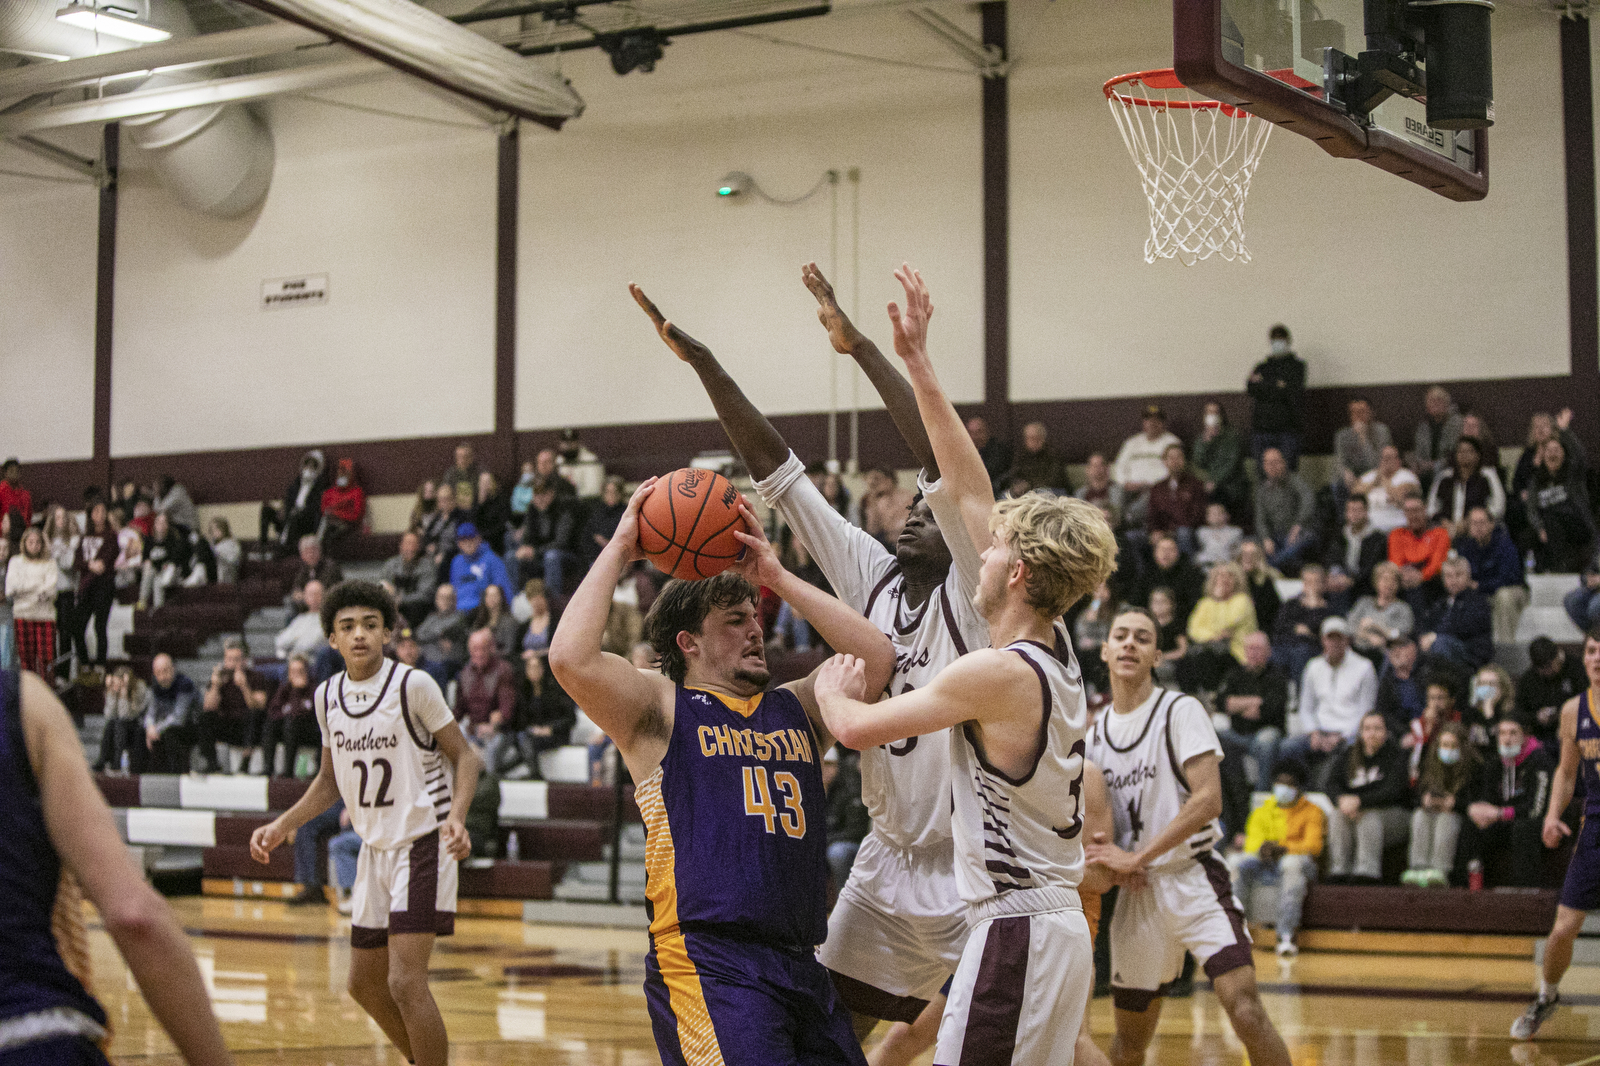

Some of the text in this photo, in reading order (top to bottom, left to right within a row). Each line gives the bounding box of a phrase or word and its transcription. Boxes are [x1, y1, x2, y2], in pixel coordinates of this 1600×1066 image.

[334, 727, 397, 754] Panthers
[697, 724, 814, 765] CHRISTIAN
[352, 758, 395, 808] 22
[1103, 758, 1158, 790] Panthrs
[742, 766, 807, 839] 43
